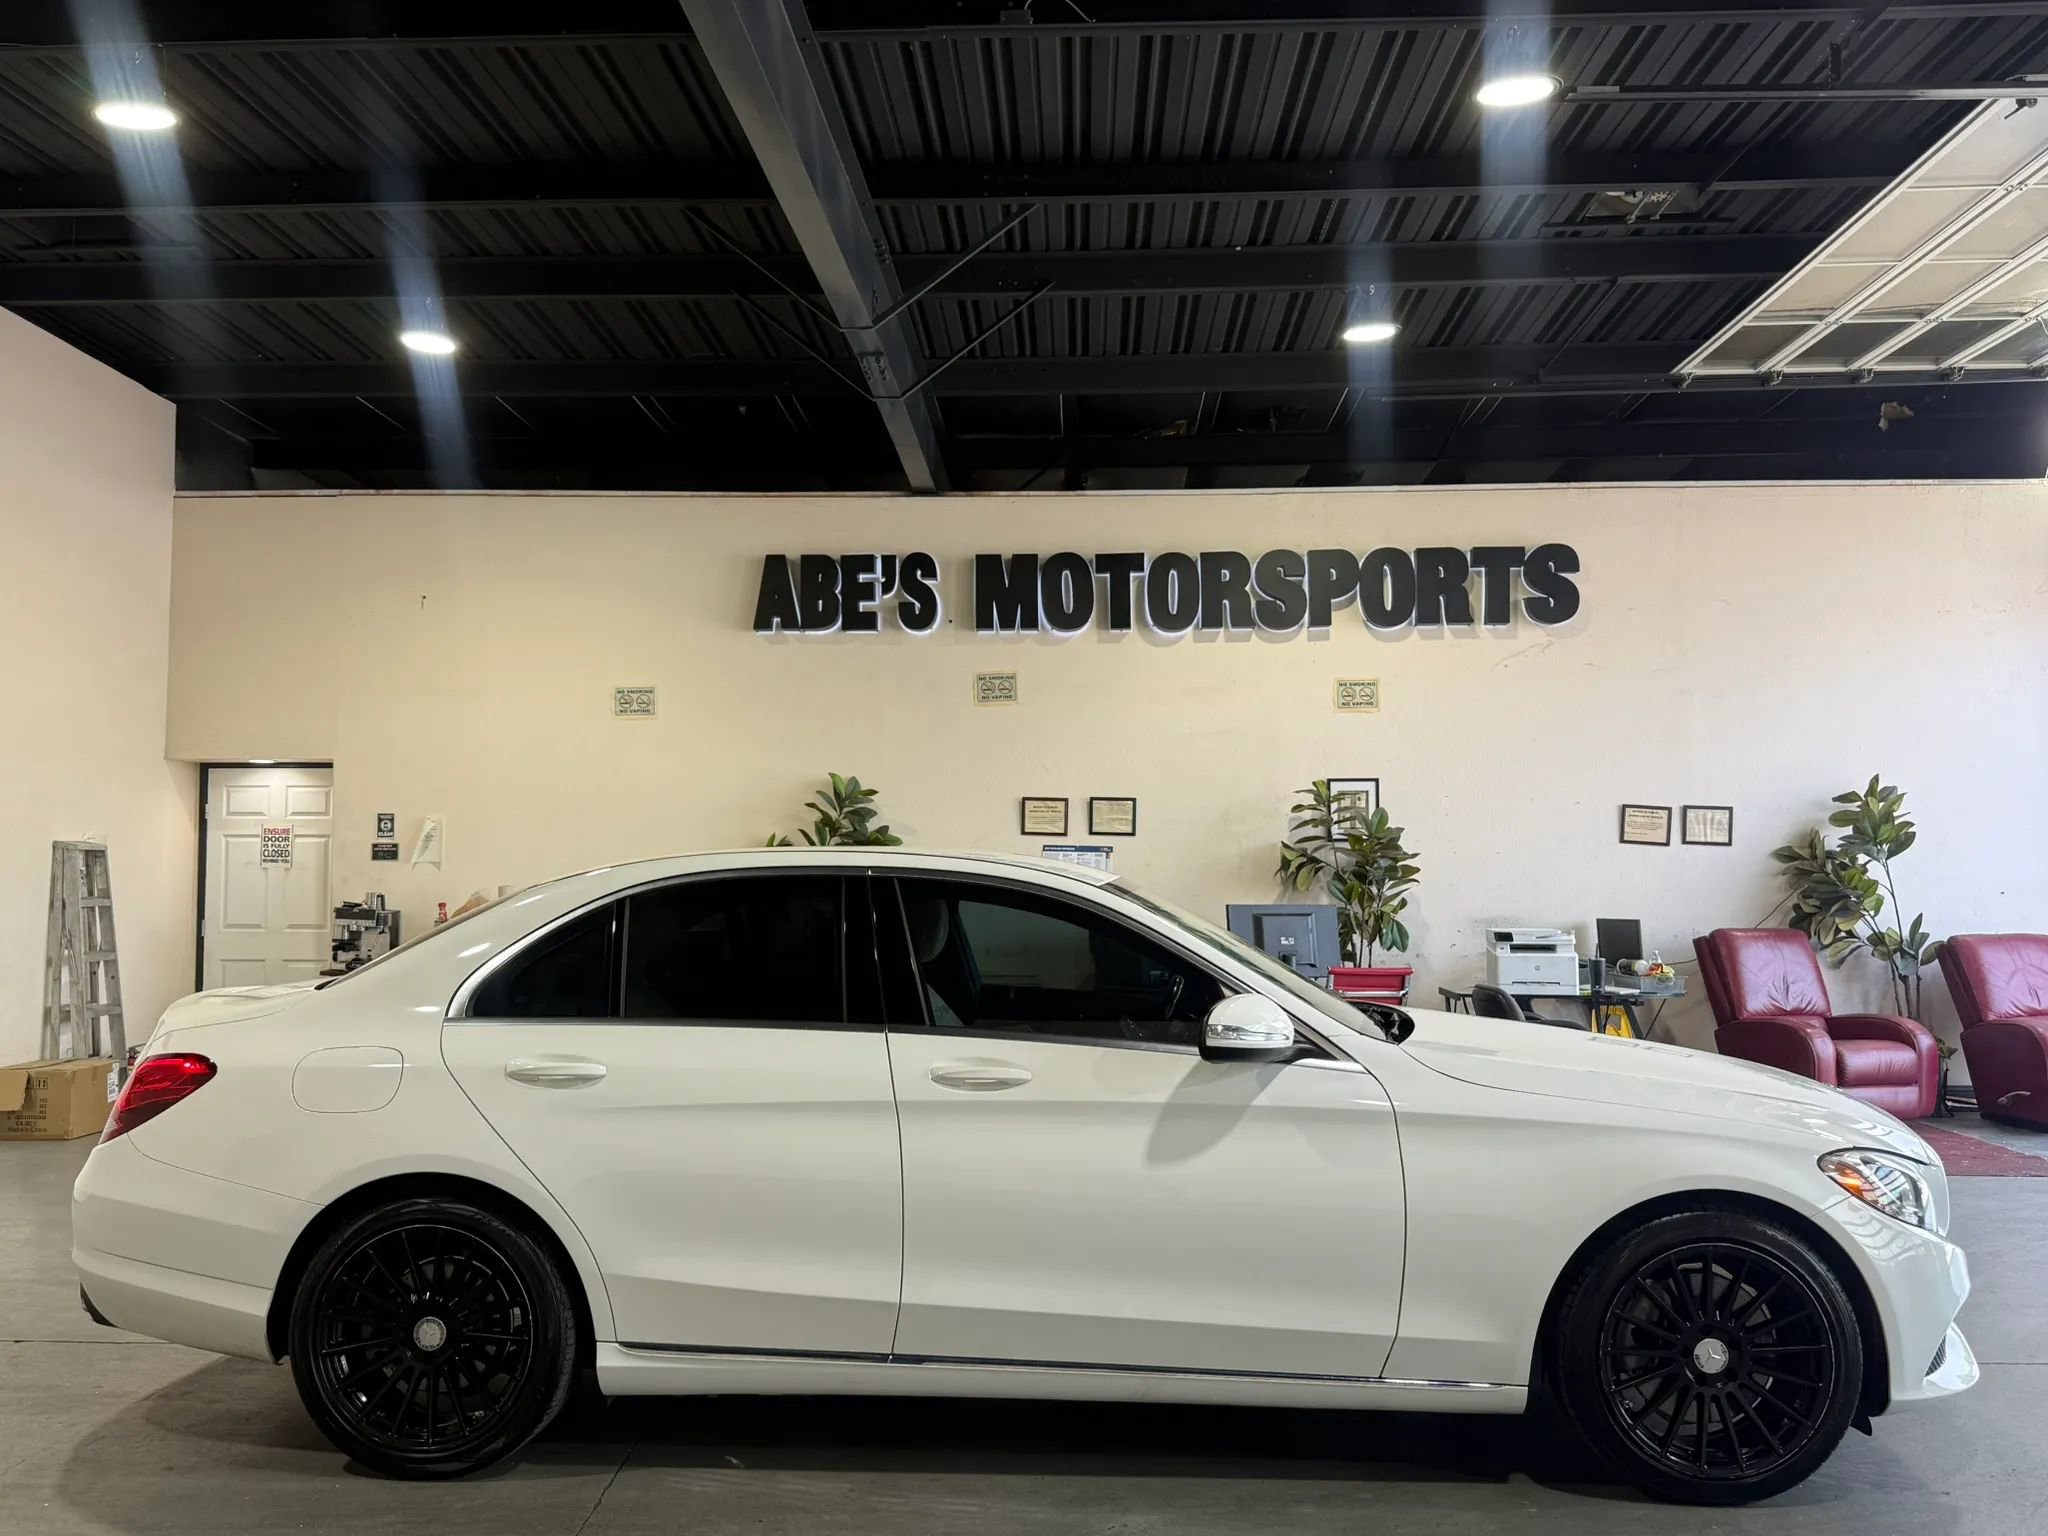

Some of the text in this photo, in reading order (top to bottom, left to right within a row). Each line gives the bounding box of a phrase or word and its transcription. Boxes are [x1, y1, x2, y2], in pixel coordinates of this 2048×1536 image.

[753, 543, 1581, 634] ABE'S MOTORSPORTS
[263, 849, 290, 858] CLOSED
